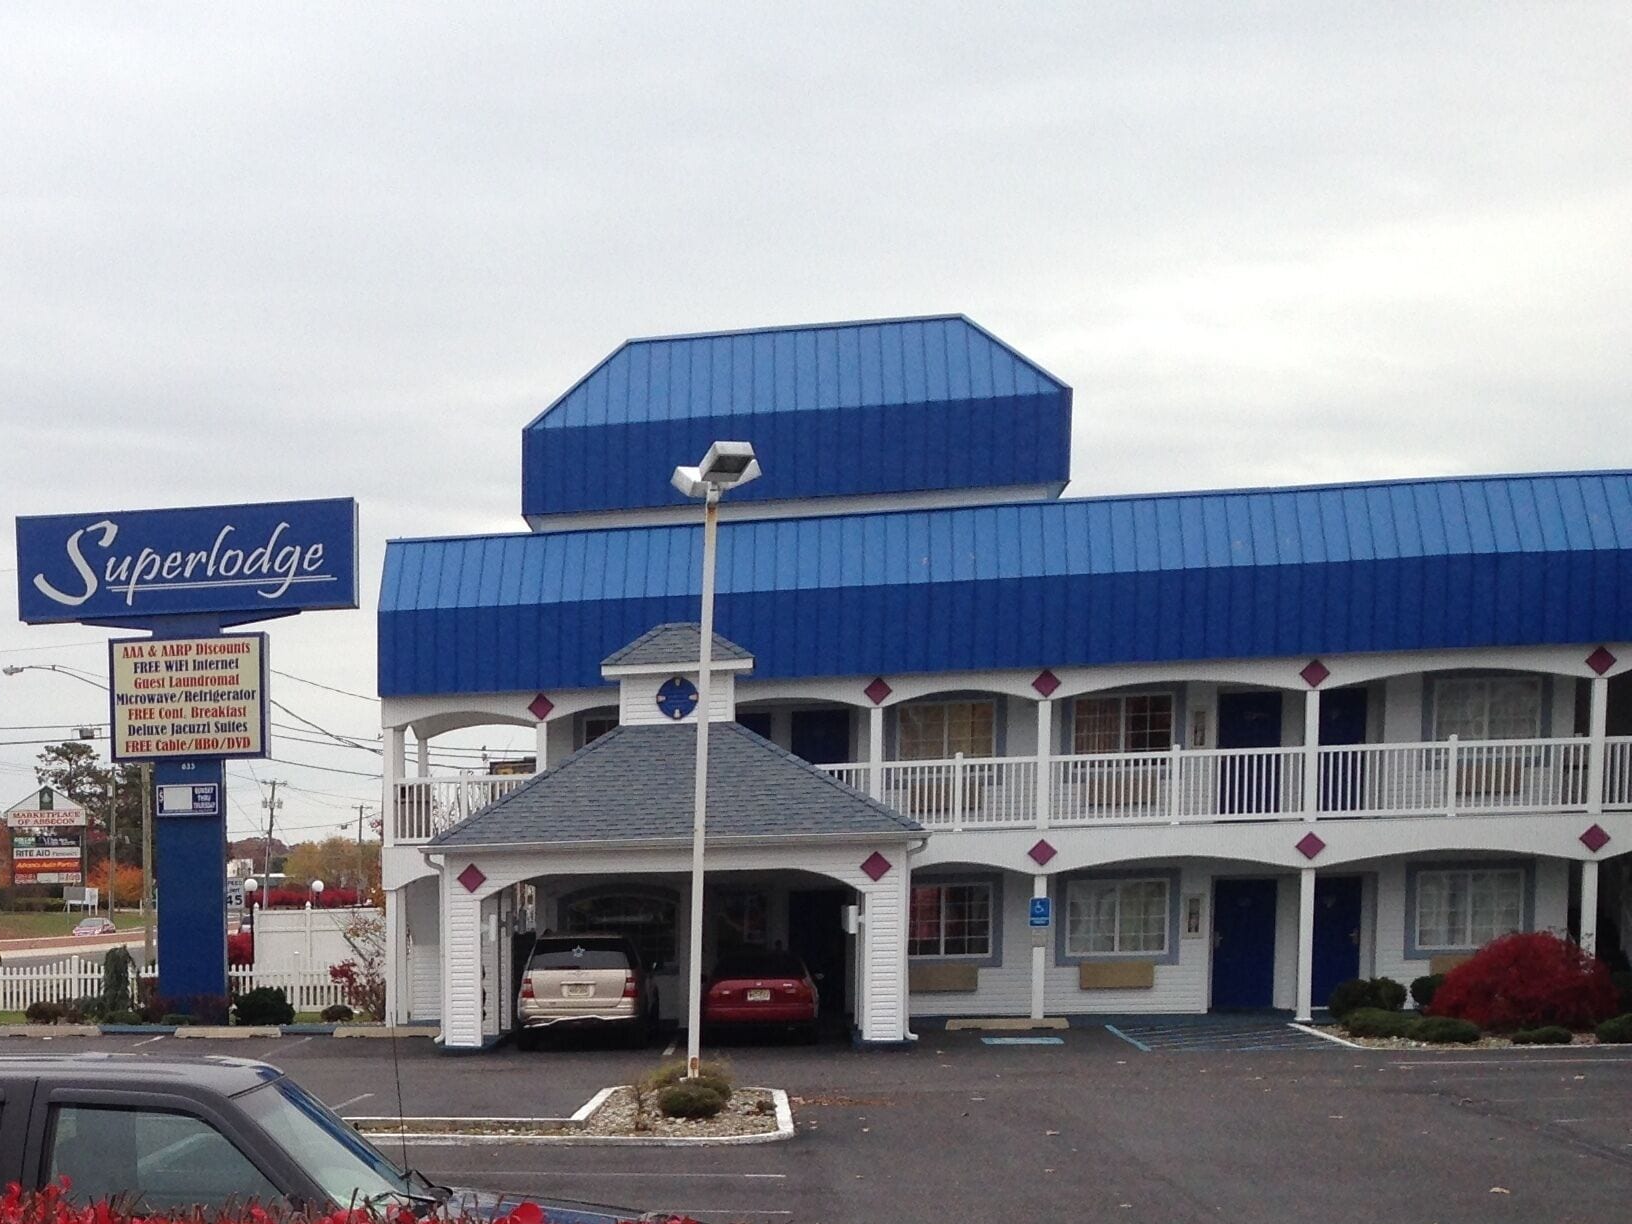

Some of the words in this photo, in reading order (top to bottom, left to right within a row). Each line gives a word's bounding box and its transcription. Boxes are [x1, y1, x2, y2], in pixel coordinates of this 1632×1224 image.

[33, 520, 325, 606] Superlodge
[123, 645, 144, 658] AAA
[148, 645, 157, 657] &
[161, 643, 192, 657] AARP
[196, 642, 250, 656] Discounts
[133, 660, 161, 674] FREE
[164, 659, 189, 672] WiFi
[193, 658, 239, 671] Internet
[134, 677, 165, 689] Guest
[169, 674, 240, 688] Laundromat
[116, 689, 256, 706] Microwave/Refrigerator
[128, 708, 155, 720] FREE
[191, 705, 247, 719] Breakfast
[128, 723, 167, 736] Deluxe
[171, 722, 210, 736] Jacuzzi
[214, 720, 248, 734] Suites
[125, 740, 152, 753] FREE
[156, 737, 251, 751] Cable/HBO/DVD
[13, 811, 81, 819] MARKETPLACE
[16, 849, 34, 857] RITE
[36, 849, 51, 857] AID
[226, 895, 242, 905] 45
